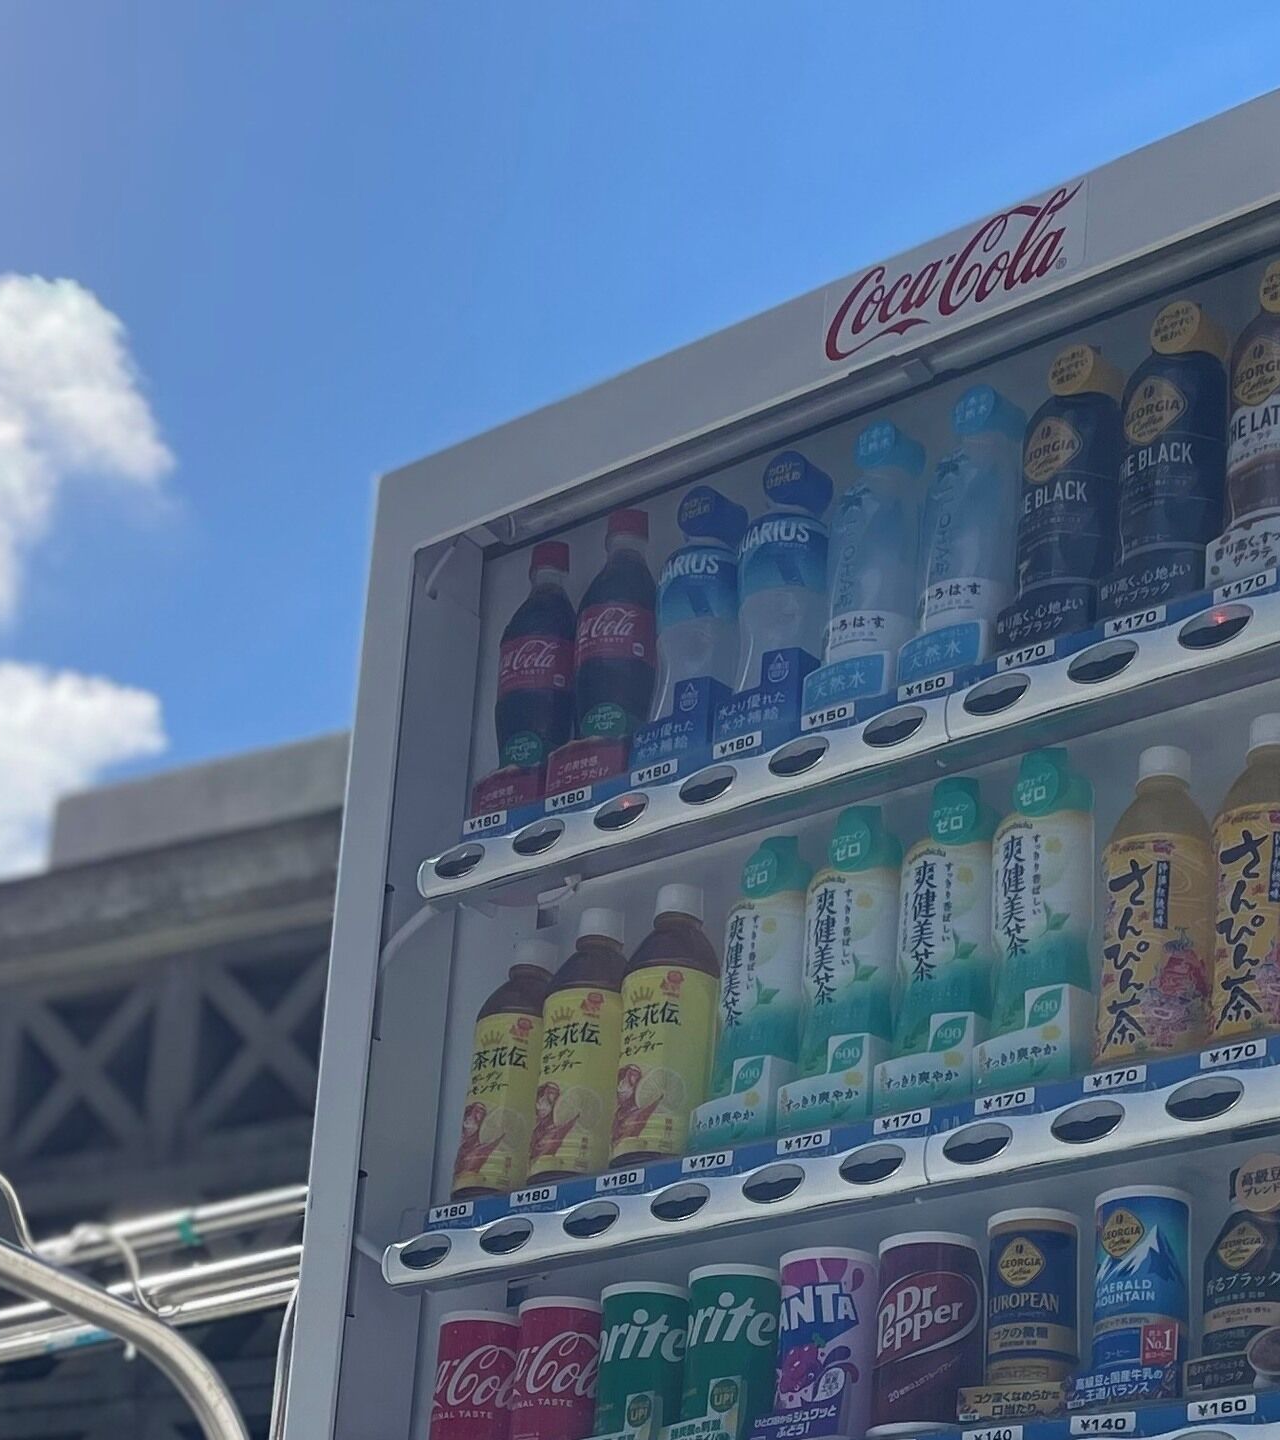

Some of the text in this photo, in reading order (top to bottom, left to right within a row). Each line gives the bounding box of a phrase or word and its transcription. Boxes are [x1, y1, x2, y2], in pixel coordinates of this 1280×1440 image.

[825, 180, 1084, 361] Coca-Cola
[1138, 442, 1193, 471] BLACK
[1034, 480, 1088, 509] BLACK
[1233, 546, 1272, 568] ザ・ラテ
[1100, 562, 1192, 600] 香り高く、心地よい
[1223, 575, 1266, 598] ¥170
[1114, 580, 1171, 608] ザ・ブラック
[1009, 615, 1063, 641] ザ・ブラック
[1113, 611, 1156, 632] ¥170
[910, 639, 962, 670] 天然水
[1005, 645, 1045, 666] ¥170
[814, 669, 867, 699] 天然水
[906, 677, 945, 696] ¥150
[718, 692, 786, 720] 水より優れた
[809, 707, 846, 725] ¥150
[721, 709, 779, 734] 水分補給
[720, 736, 754, 754] ¥180
[638, 763, 670, 781] ¥180
[552, 791, 584, 807] ¥180
[1020, 785, 1048, 808] ゼロ
[470, 814, 500, 830] ¥180
[936, 814, 964, 834] ゼロ
[833, 844, 862, 864] ゼロ
[1002, 835, 1031, 960] 爽健美茶
[911, 860, 937, 983] 爽健美茶
[1215, 830, 1269, 1030] さんぴん茶
[812, 888, 837, 1007] 爽健美茶
[1100, 857, 1154, 1054] さんぴん茶
[721, 914, 745, 1029] 爽健美茶
[624, 1000, 682, 1030] 茶花伝
[1033, 998, 1059, 1017] 600
[544, 1021, 600, 1049] 茶花伝
[936, 1026, 963, 1042] 600
[473, 1046, 528, 1071] 茶花伝
[983, 1043, 1059, 1070] すっきり爽やか
[1210, 1045, 1256, 1063] ¥170
[886, 1068, 960, 1091] すっきり爽やか
[1093, 1070, 1137, 1087] ¥170
[785, 1087, 860, 1113] すっきり爽やか
[984, 1092, 1025, 1109] ¥170
[883, 1113, 921, 1129] ¥170
[785, 1134, 822, 1150] ¥170
[690, 1154, 725, 1168] ¥170
[604, 1173, 636, 1187] ¥180
[1242, 1182, 1280, 1199] ブレンド
[517, 1189, 549, 1202] ¥180
[436, 1205, 466, 1218] ¥180
[1000, 1258, 1041, 1270] GEORGIA
[896, 1284, 938, 1314] Dr
[876, 1300, 964, 1358] Pepper
[1145, 1328, 1173, 1351] No.1
[1084, 1382, 1150, 1402] 王道バランス
[538, 1398, 574, 1408] TASTE
[992, 1404, 1036, 1417] 口当たり
[1198, 1399, 1246, 1416] ¥160
[459, 1410, 494, 1420] TASTE
[1081, 1418, 1126, 1431] ¥140
